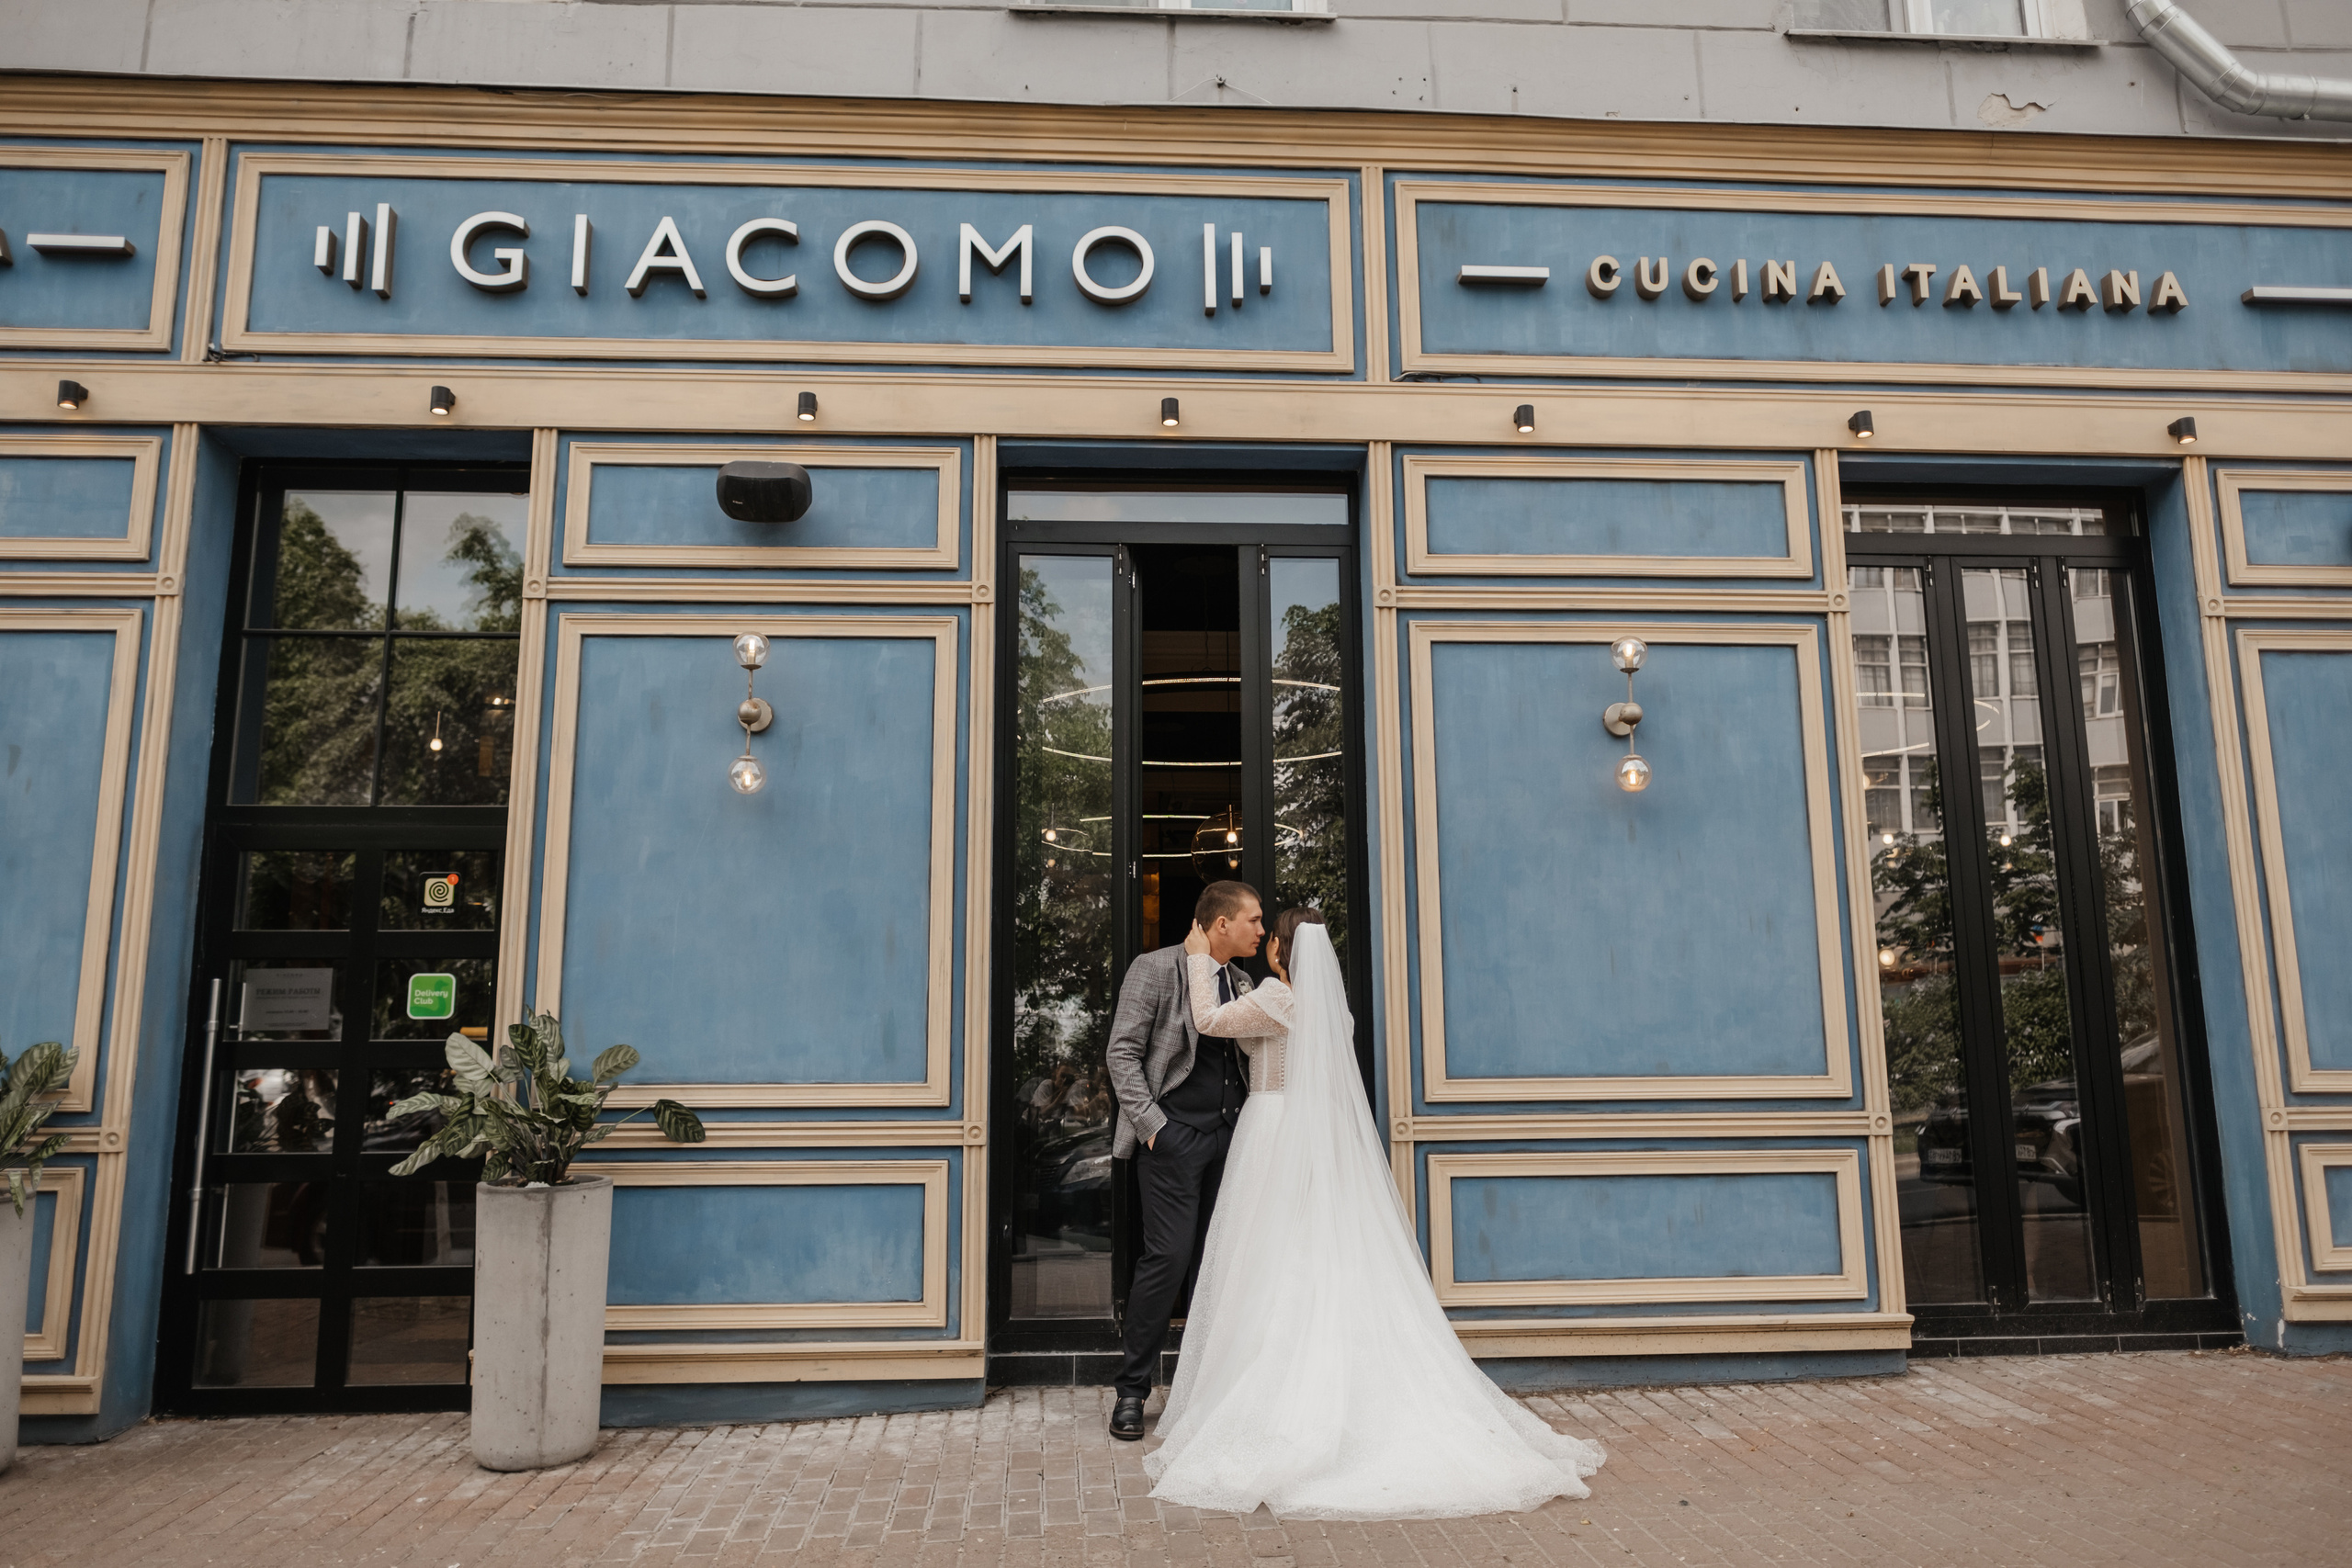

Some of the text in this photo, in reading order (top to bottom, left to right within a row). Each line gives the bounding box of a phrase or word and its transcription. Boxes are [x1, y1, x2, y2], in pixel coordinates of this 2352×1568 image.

[450, 210, 1155, 303] GIACOMO
[1586, 254, 2189, 315] CUCINA ITALIANA
[414, 989, 448, 998] Delivery
